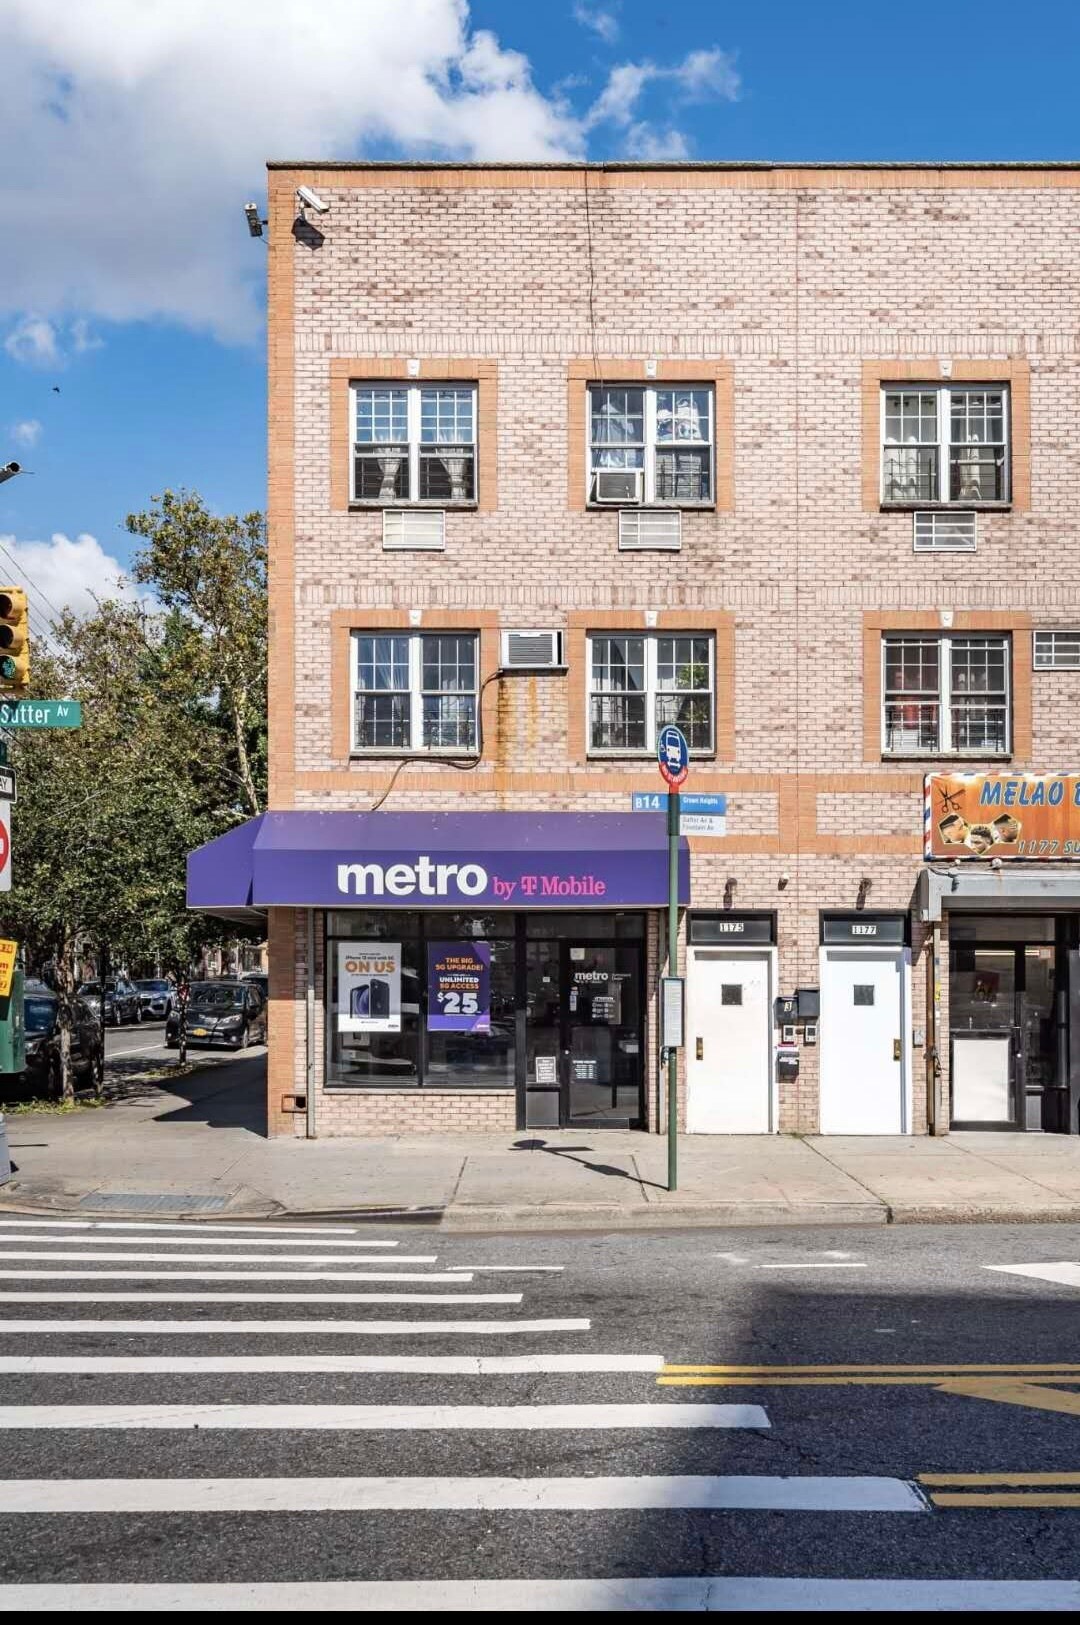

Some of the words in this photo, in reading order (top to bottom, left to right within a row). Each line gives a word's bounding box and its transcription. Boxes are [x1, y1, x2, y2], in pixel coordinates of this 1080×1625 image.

[1, 704, 50, 723] Sutter
[57, 704, 69, 717] Av
[980, 781, 1064, 806] MELAO
[635, 795, 660, 809] B14
[1018, 840, 1058, 854] 1177
[337, 856, 488, 896] metro
[493, 876, 517, 900] by
[541, 876, 606, 896] Mobile
[719, 922, 744, 933] 1175
[851, 925, 877, 935] 1177
[345, 961, 370, 973] ON
[374, 961, 395, 973] US
[574, 971, 609, 980] metro
